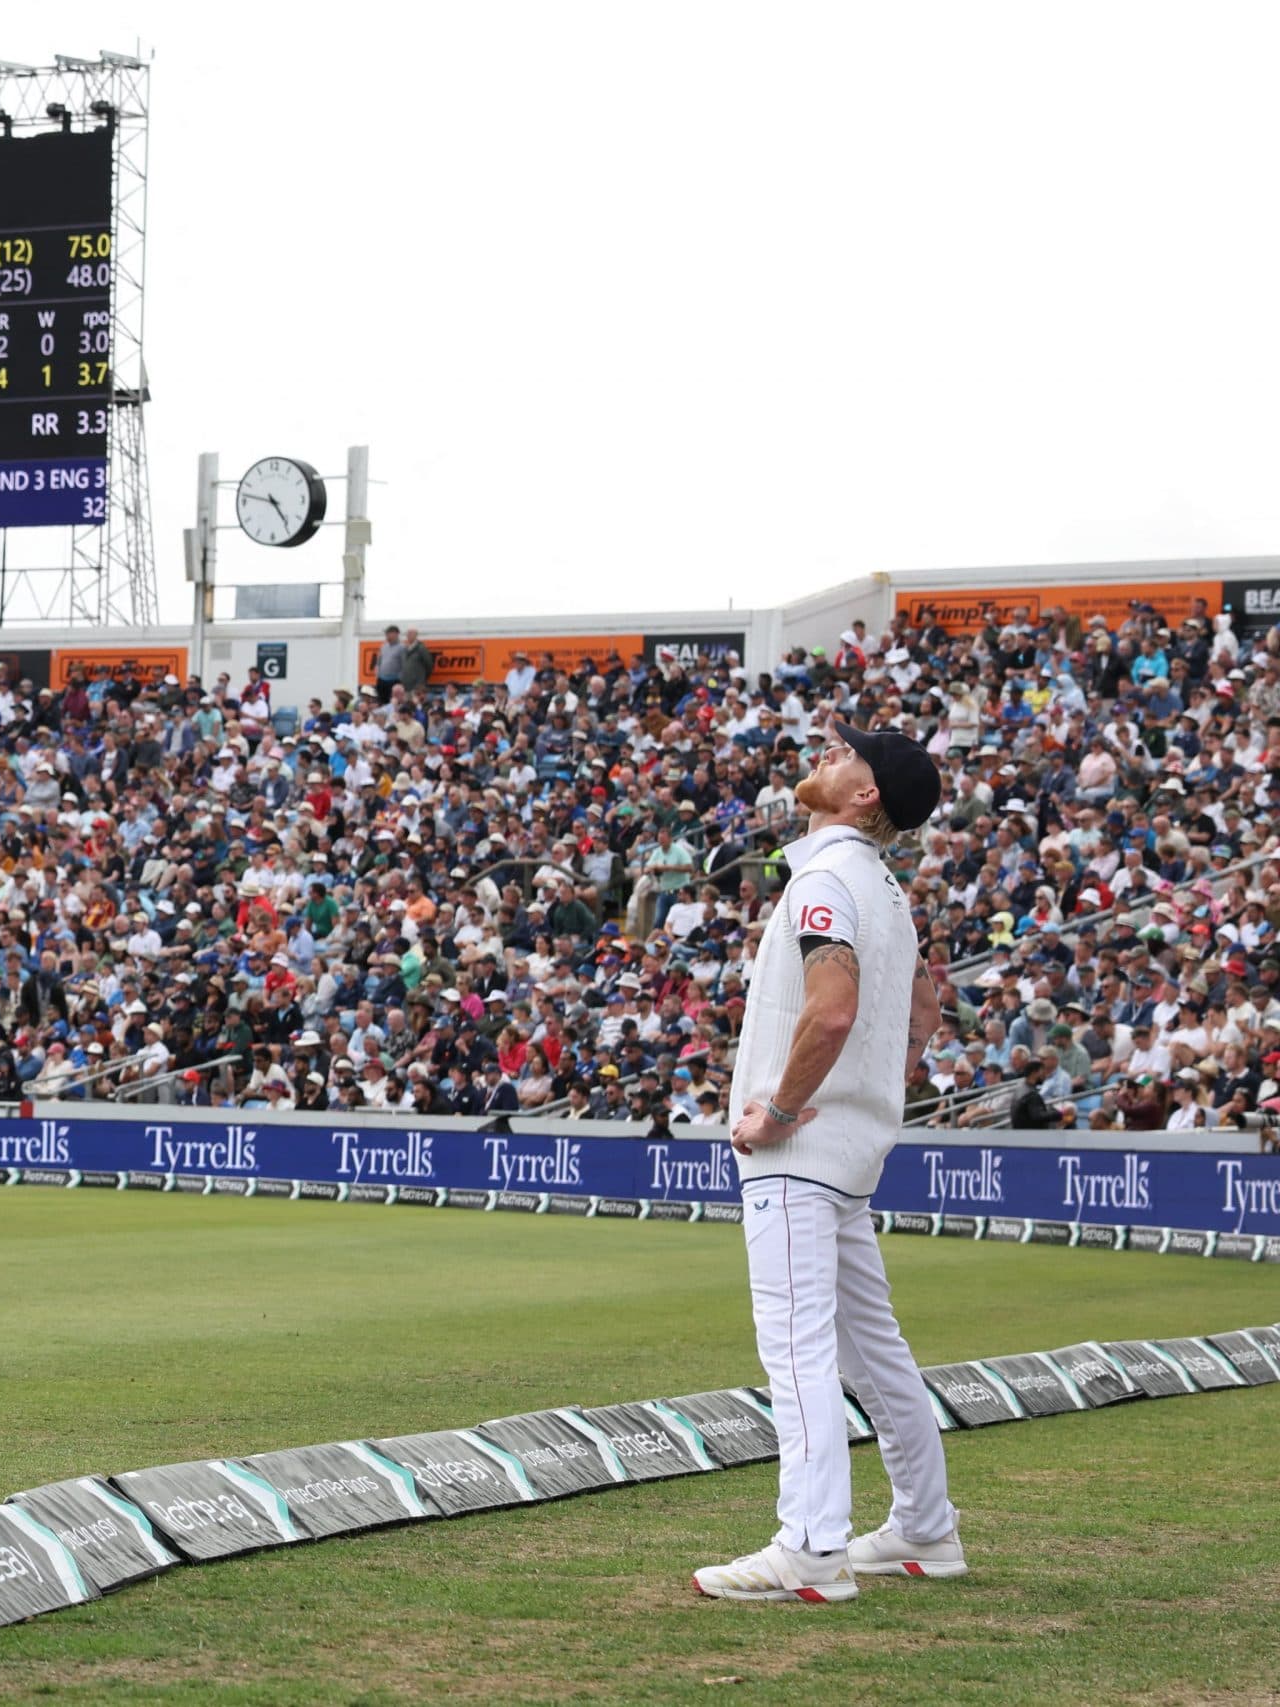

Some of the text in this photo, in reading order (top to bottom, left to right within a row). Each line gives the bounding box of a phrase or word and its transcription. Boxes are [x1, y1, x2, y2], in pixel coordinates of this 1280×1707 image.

[68, 233, 111, 258] 75.0
[67, 264, 110, 288] 48.0
[38, 312, 55, 328] W
[83, 312, 109, 329] rpo
[40, 333, 54, 356] 0
[78, 331, 109, 354] 3.0
[42, 365, 51, 387] 1
[78, 362, 108, 386] 3.7
[31, 410, 106, 436] RR 3.3
[34, 470, 44, 490] 3
[50, 468, 89, 490] ENG
[94, 468, 104, 488] 3
[82, 498, 104, 518] 32
[264, 659, 279, 675] G
[800, 905, 832, 931] IG
